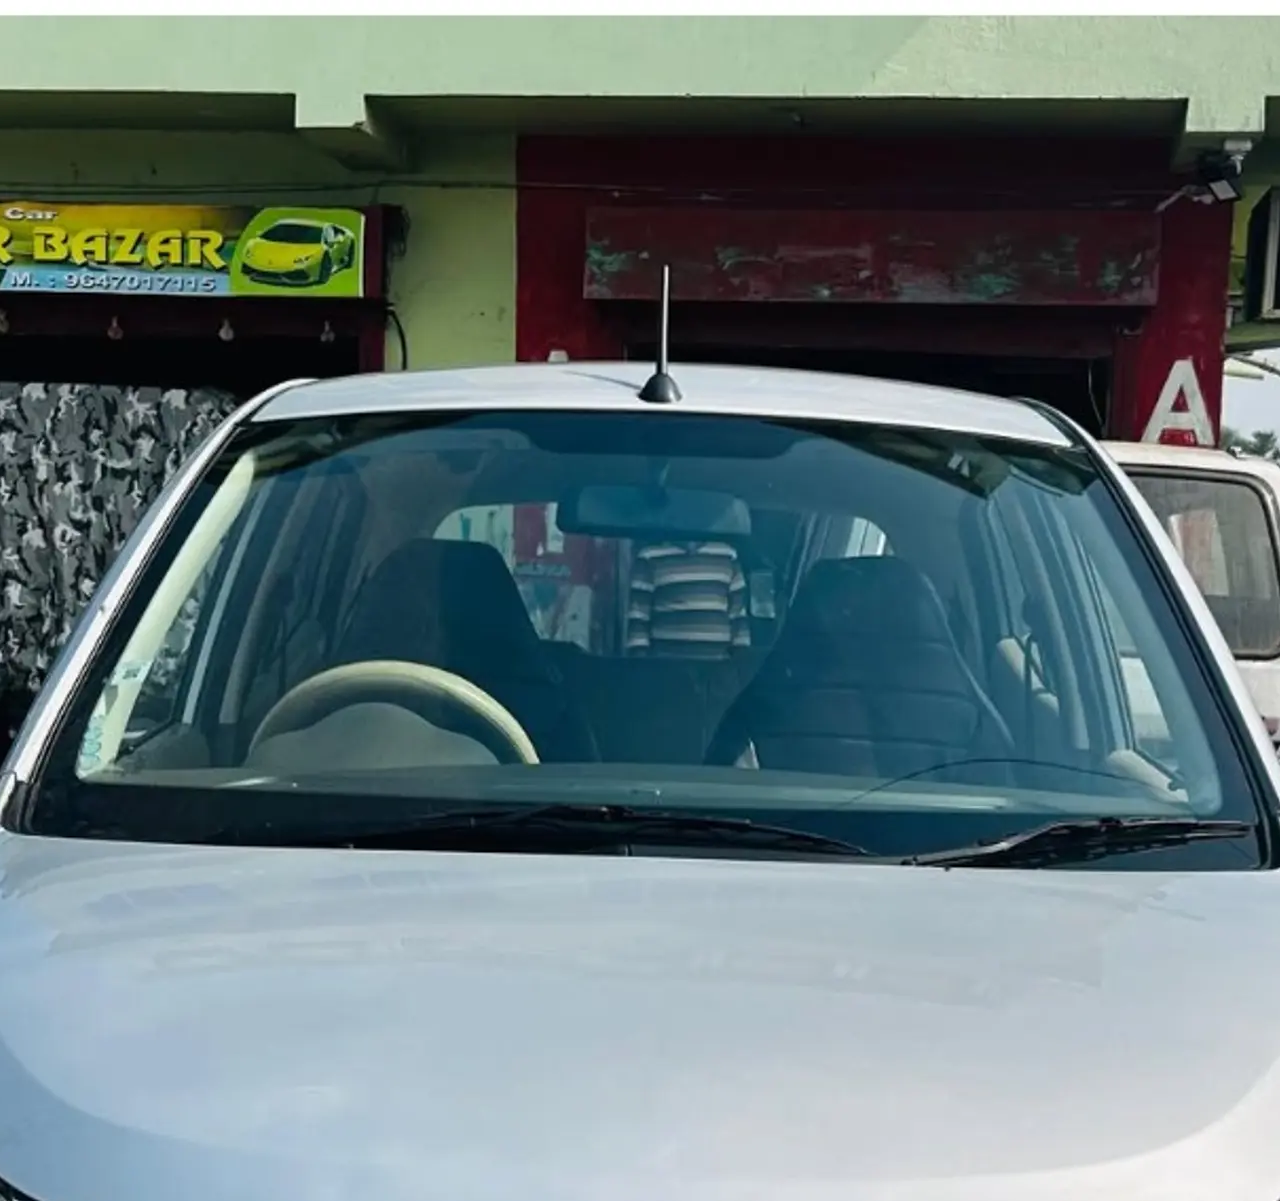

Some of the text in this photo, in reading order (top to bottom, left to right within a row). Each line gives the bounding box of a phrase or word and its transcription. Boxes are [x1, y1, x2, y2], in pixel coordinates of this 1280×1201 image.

[4, 207, 58, 221] Car
[31, 226, 228, 271] BAZAR
[1140, 356, 1216, 446] A
